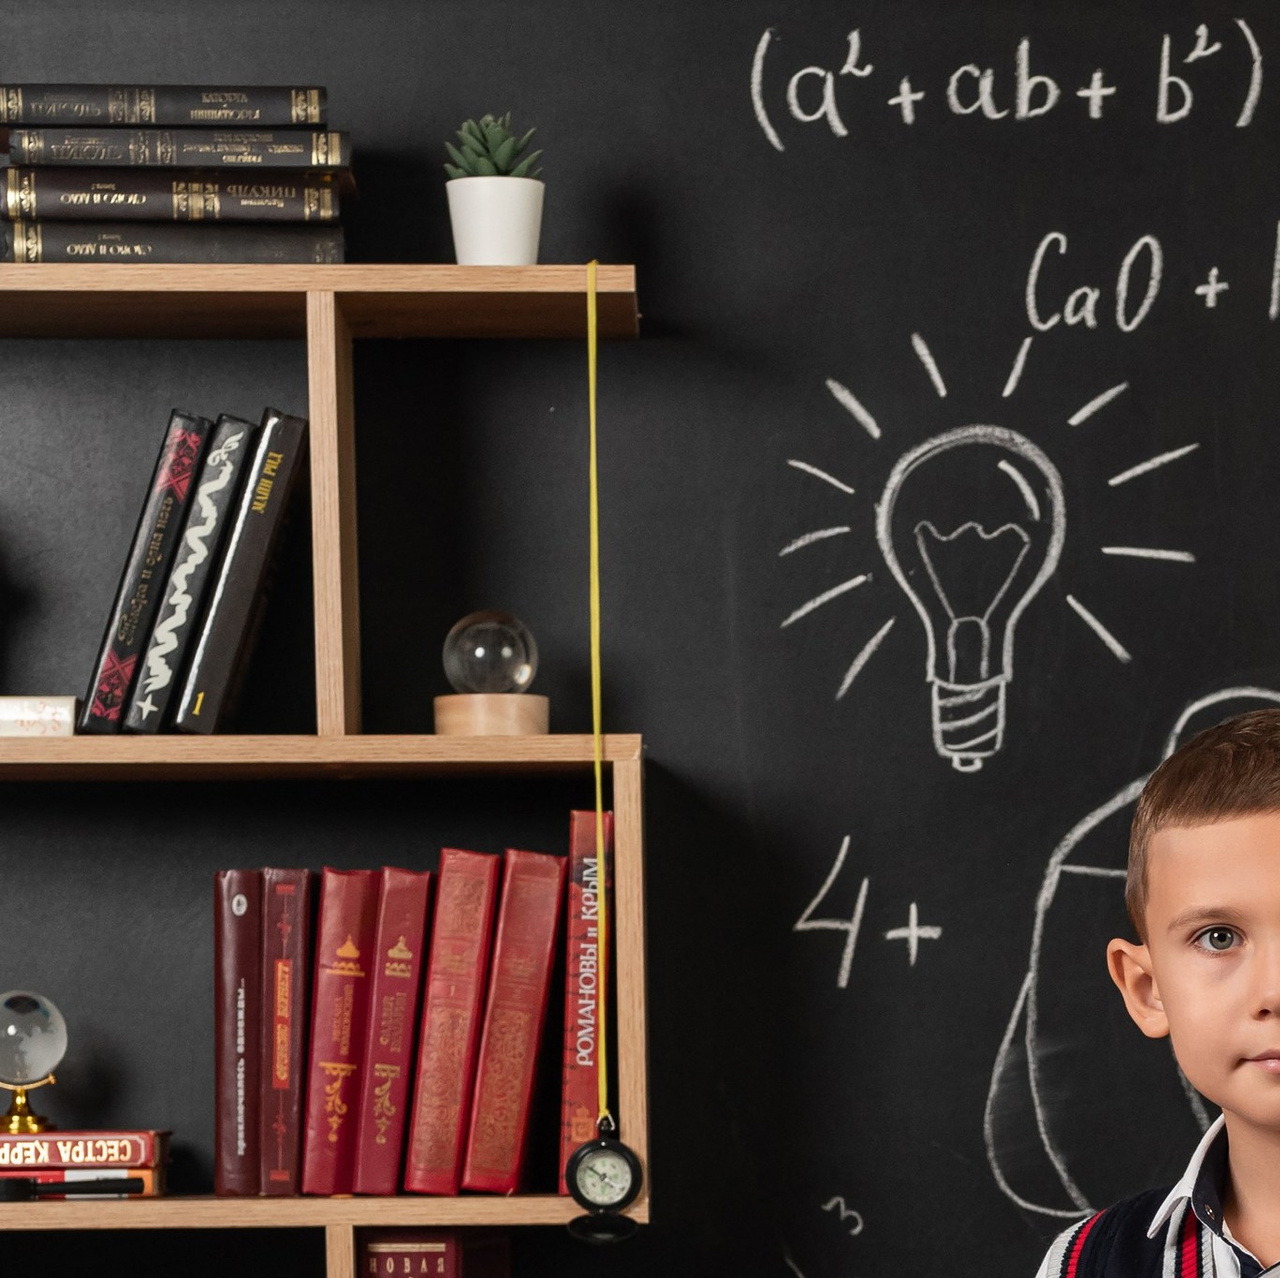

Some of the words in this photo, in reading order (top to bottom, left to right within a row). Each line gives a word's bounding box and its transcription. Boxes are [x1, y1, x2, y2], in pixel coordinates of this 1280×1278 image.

[227, 185, 296, 199] ПИКУЛЬ
[1025, 231, 1162, 332] CaO
[251, 478, 273, 513] МАЙН
[263, 451, 283, 477] РИД
[581, 857, 598, 921] КРЫМ
[576, 943, 598, 1067] РОМАНОВЫ
[57, 1140, 131, 1163] СЕСТРА
[369, 1257, 445, 1273] НОВАЯ
